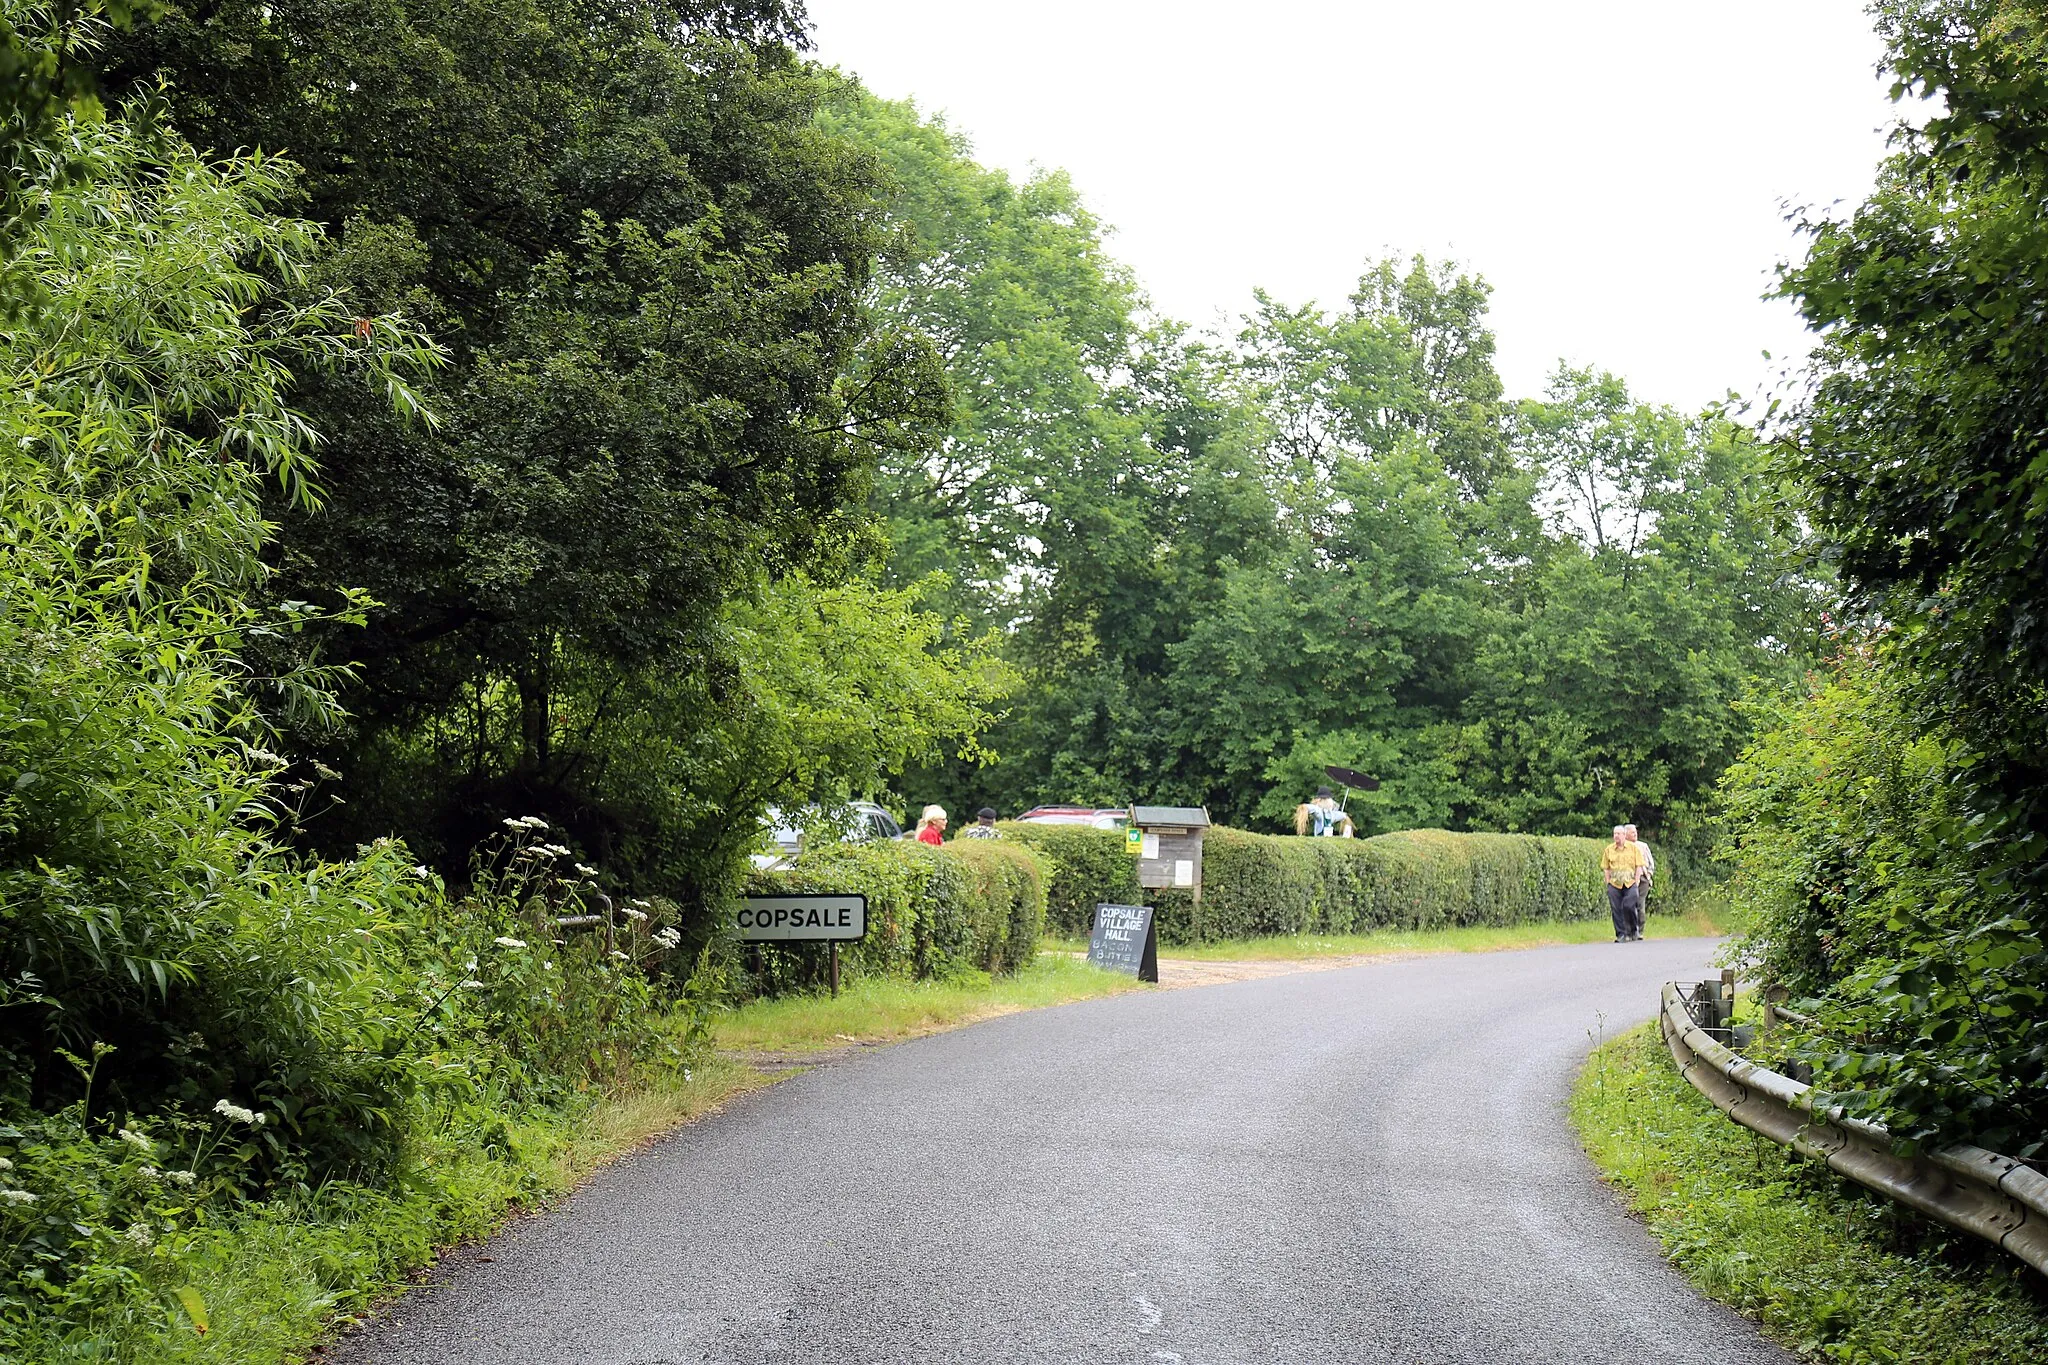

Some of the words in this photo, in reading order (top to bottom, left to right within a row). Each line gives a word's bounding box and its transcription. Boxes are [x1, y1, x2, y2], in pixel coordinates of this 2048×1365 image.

[737, 908, 851, 928] COPSALE
[1101, 908, 1146, 921] COPSALE
[1100, 918, 1143, 931] VILLAGE
